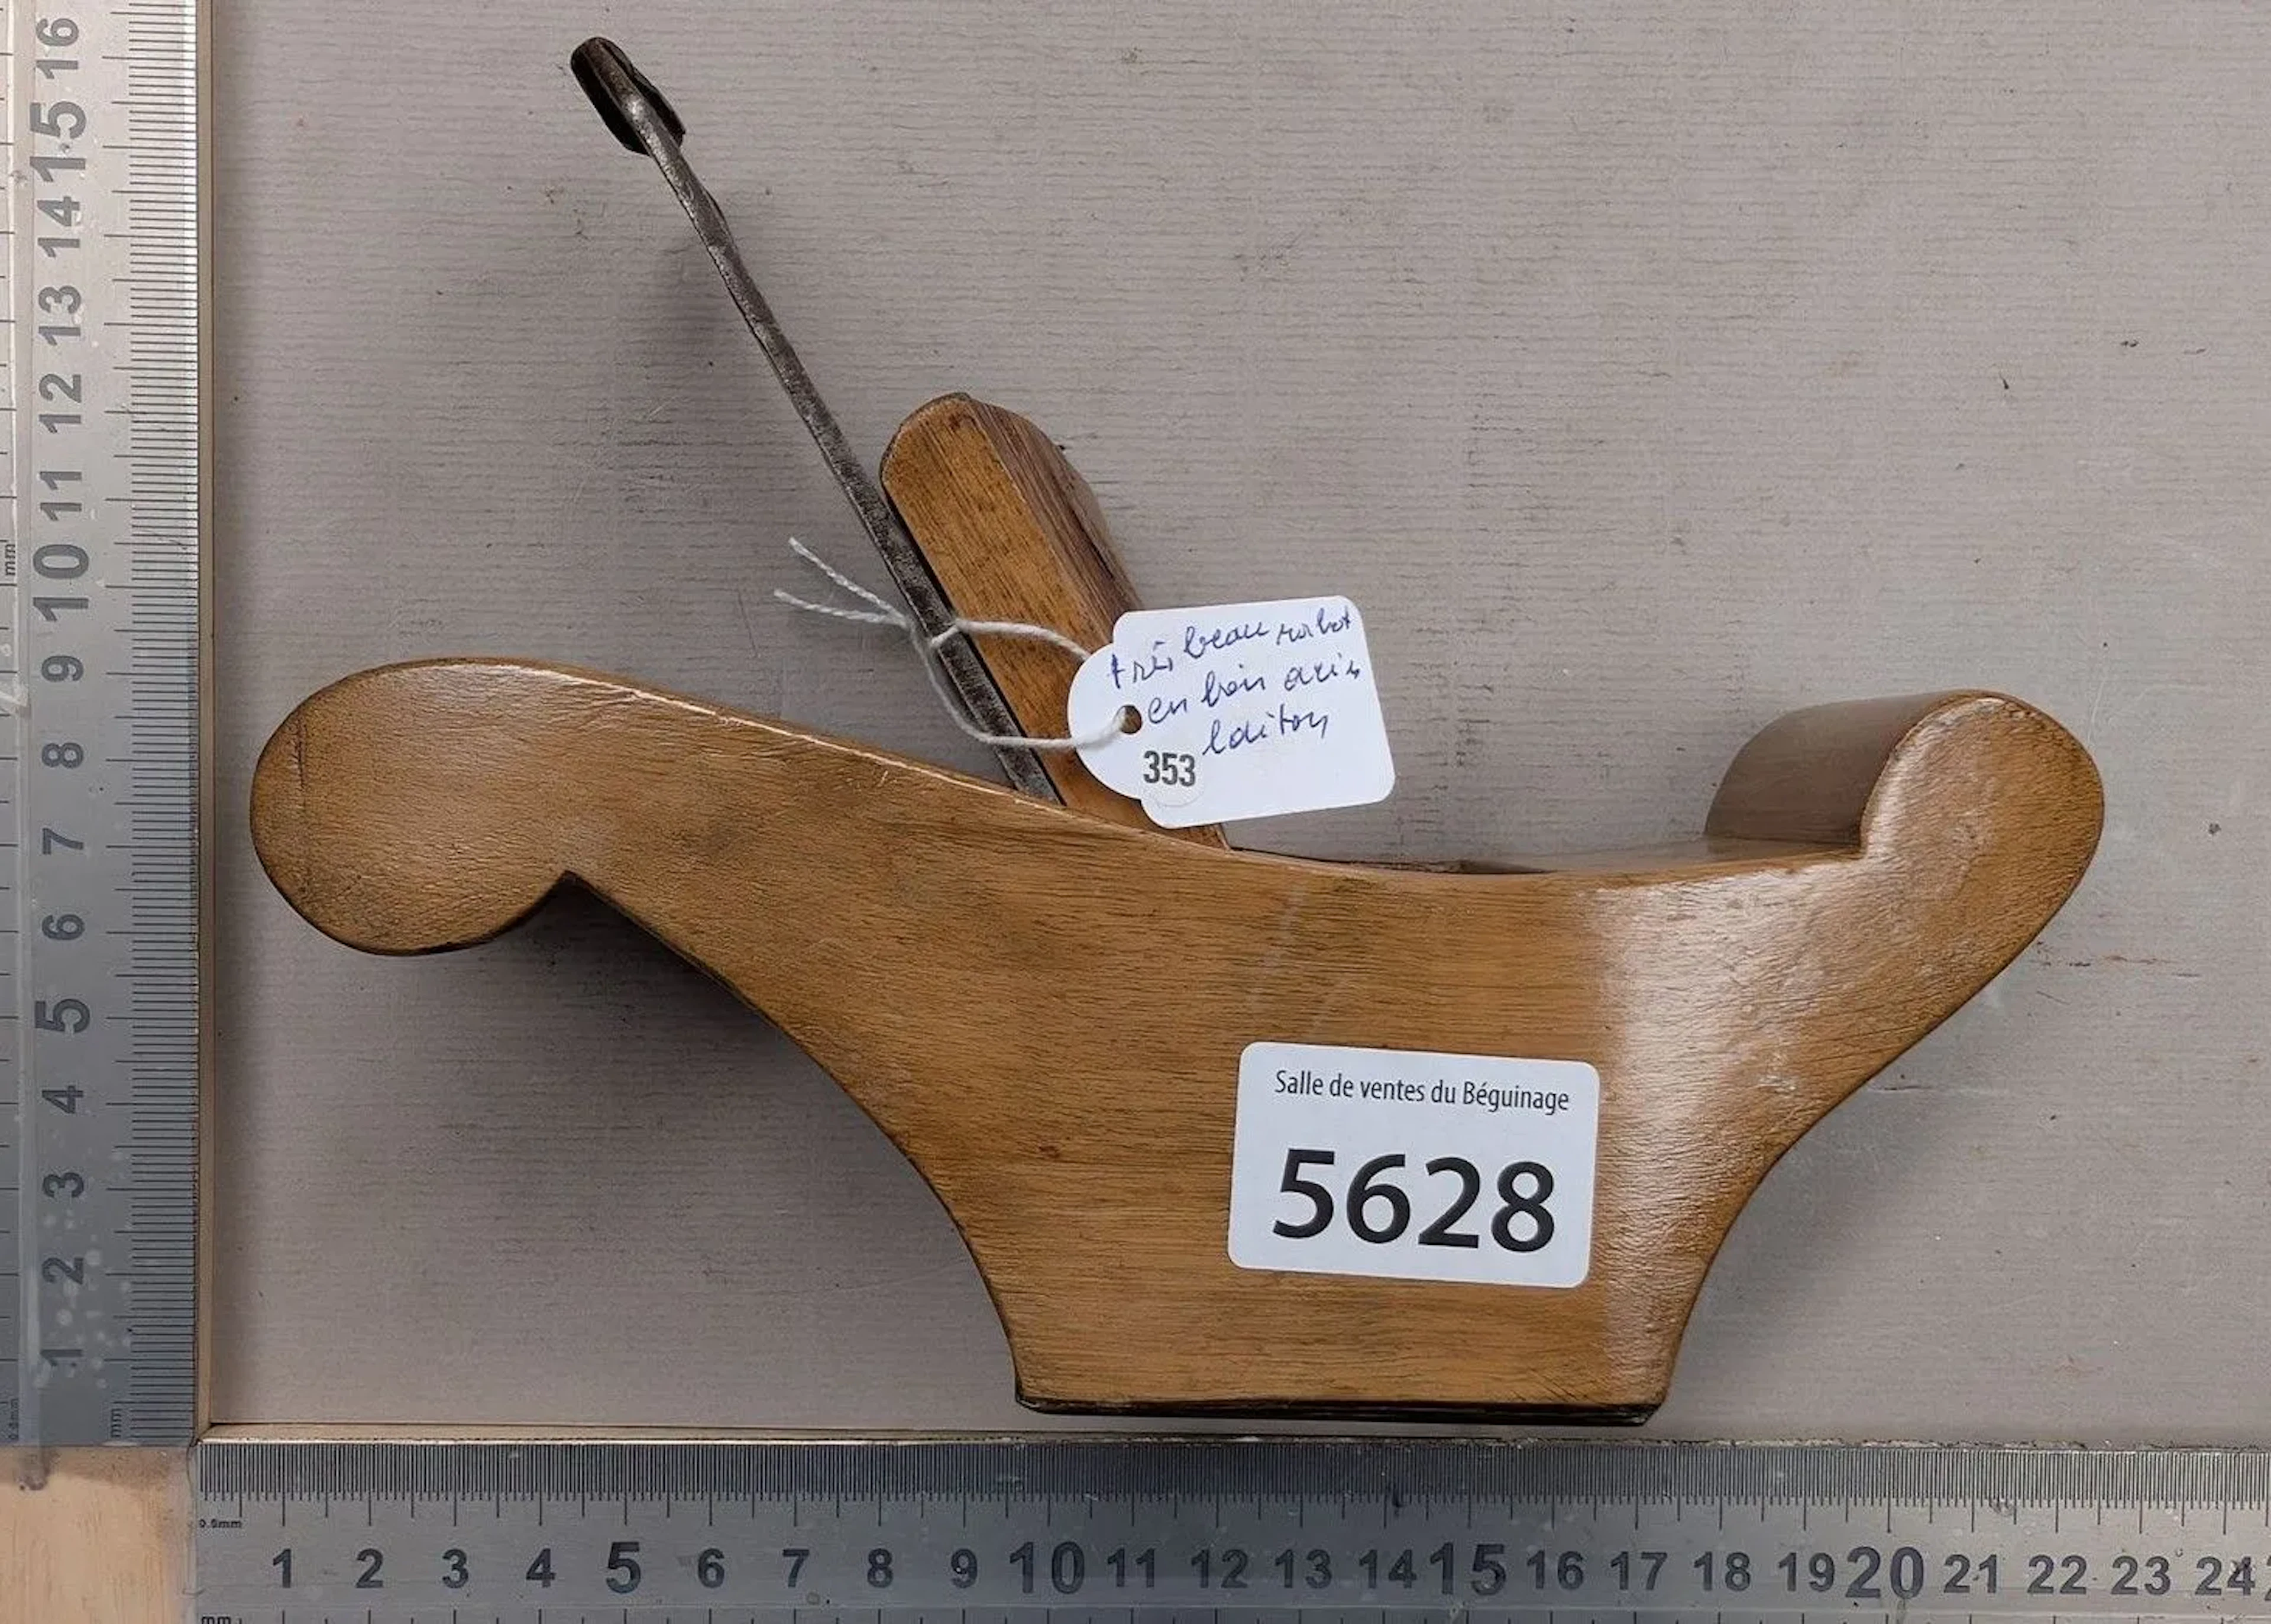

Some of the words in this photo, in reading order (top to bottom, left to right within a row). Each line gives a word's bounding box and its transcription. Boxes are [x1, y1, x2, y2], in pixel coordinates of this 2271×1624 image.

[35, 17, 80, 79] 16
[30, 101, 87, 183] 15
[37, 196, 80, 258] 14
[38, 285, 82, 347] 13
[38, 373, 82, 434] 12
[39, 471, 82, 522] 11
[4, 544, 16, 576] mm
[33, 544, 89, 622] 10
[41, 655, 84, 682] 9
[1147, 697, 1188, 724] en
[41, 742, 85, 769] 8
[1143, 750, 1196, 787] 353
[42, 828, 85, 855] 7
[41, 914, 85, 940] 6
[35, 998, 90, 1034] 5
[42, 1085, 84, 1114] 4
[1274, 1069, 1324, 1096] Salle
[1329, 1073, 1355, 1098] de
[1360, 1078, 1425, 1102] ventes
[1431, 1079, 1456, 1104] du
[1463, 1080, 1569, 1116] Béguinage
[43, 1172, 85, 1199] 3
[1272, 1148, 1555, 1253] 5628
[42, 1257, 84, 1285] 2
[40, 1348, 84, 1367] 1
[272, 1548, 292, 1589] 1
[355, 1548, 384, 1589] 2
[442, 1548, 470, 1589] 3
[526, 1548, 556, 1588] 4
[606, 1542, 641, 1593] 5
[698, 1548, 725, 1589] 6
[782, 1548, 810, 1588] 7
[866, 1548, 894, 1589] 8
[950, 1548, 978, 1589] 9
[1009, 1541, 1085, 1594] 10
[1107, 1548, 1155, 1588] 11
[1191, 1549, 1248, 1589] 12
[1274, 1549, 1332, 1589] 13
[1360, 1549, 1417, 1589] 14
[1429, 1542, 1506, 1596] 15
[1526, 1549, 1584, 1590] 16
[1610, 1551, 1668, 1591] 17
[1694, 1551, 1752, 1592] 18
[1778, 1552, 1835, 1593] 19
[1845, 1546, 1924, 1599] 20
[1943, 1554, 1999, 1594] 21
[2027, 1555, 2087, 1595] 22
[2111, 1556, 2171, 1596] 23
[2195, 1556, 2256, 1596] 24
